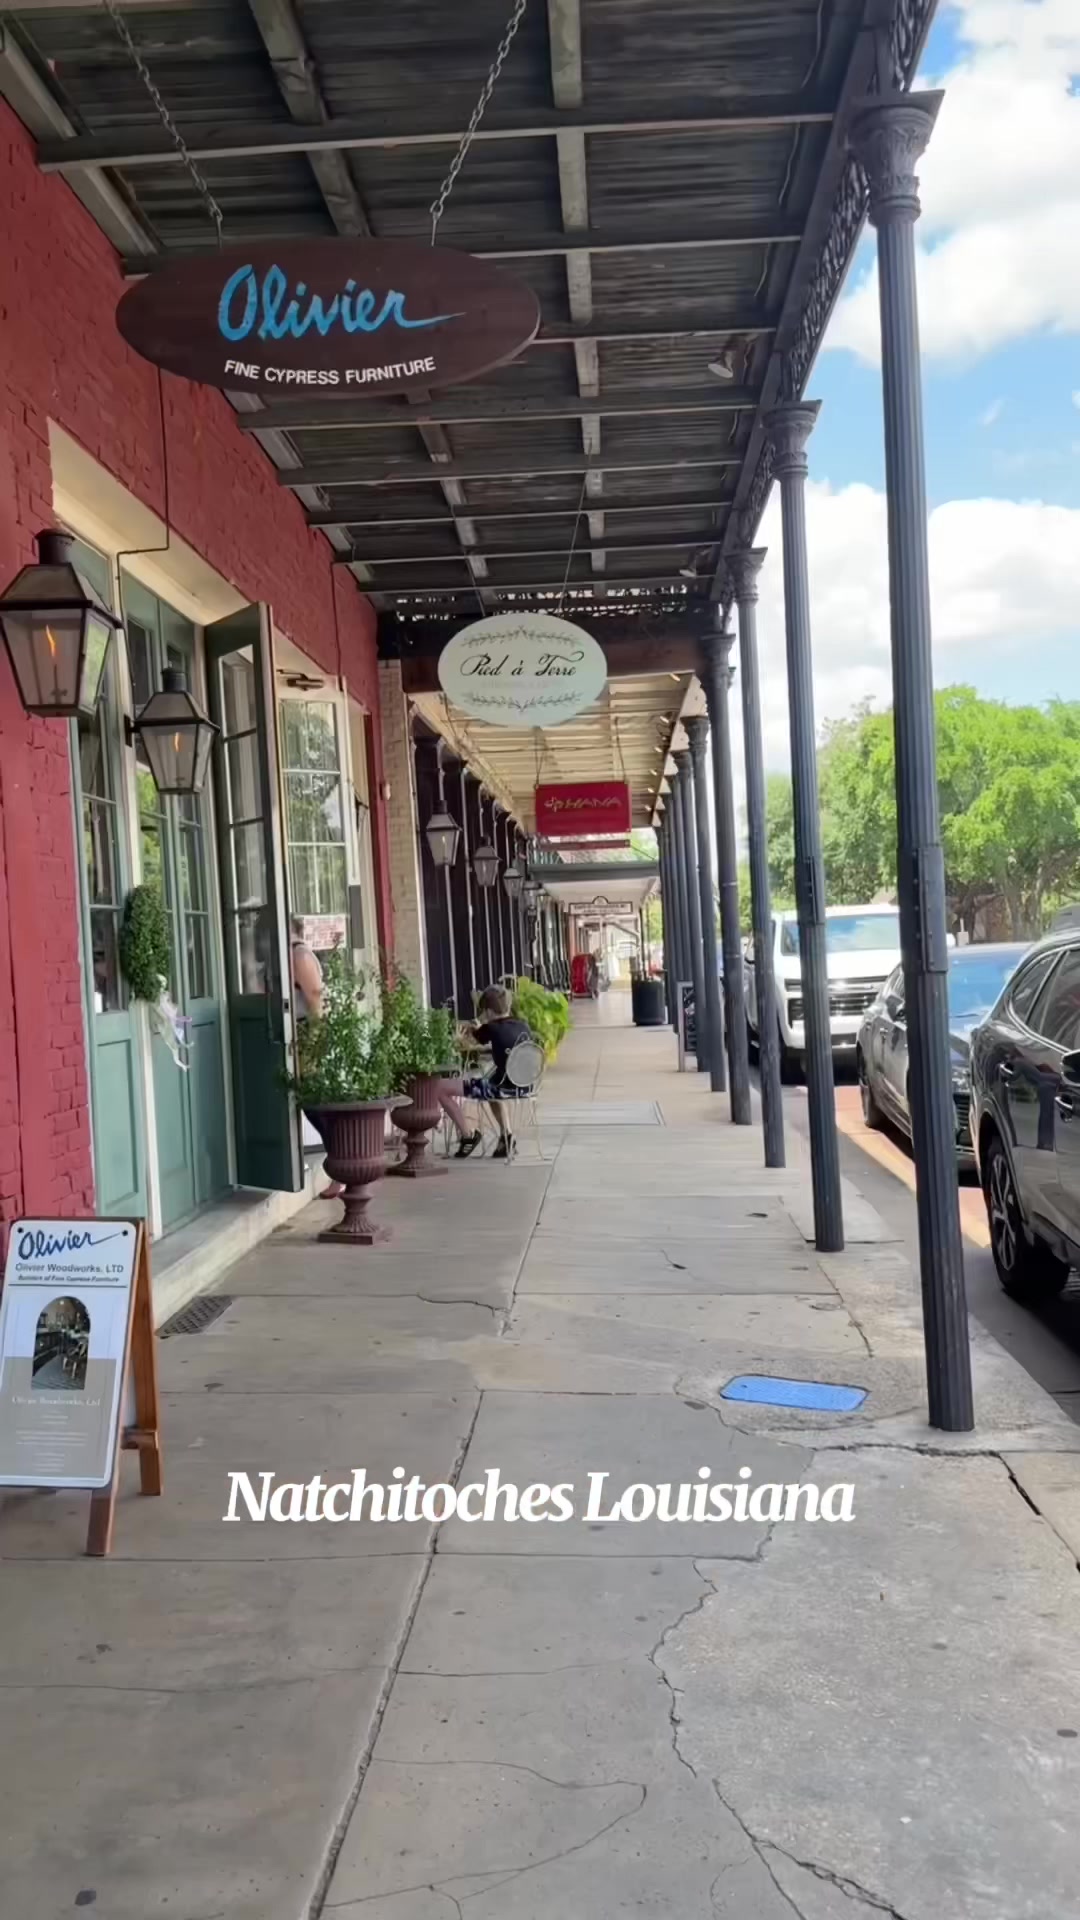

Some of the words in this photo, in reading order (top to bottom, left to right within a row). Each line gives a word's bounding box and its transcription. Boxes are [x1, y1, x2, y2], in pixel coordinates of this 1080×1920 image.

[218, 264, 467, 341] Olivier
[224, 359, 261, 380] FINE
[264, 364, 340, 385] CYPRESS
[345, 356, 437, 383] FURNITURE
[460, 652, 511, 676] Pied
[535, 651, 585, 676] Terre
[18, 1229, 121, 1260] Olivier
[105, 1264, 124, 1274] LTD
